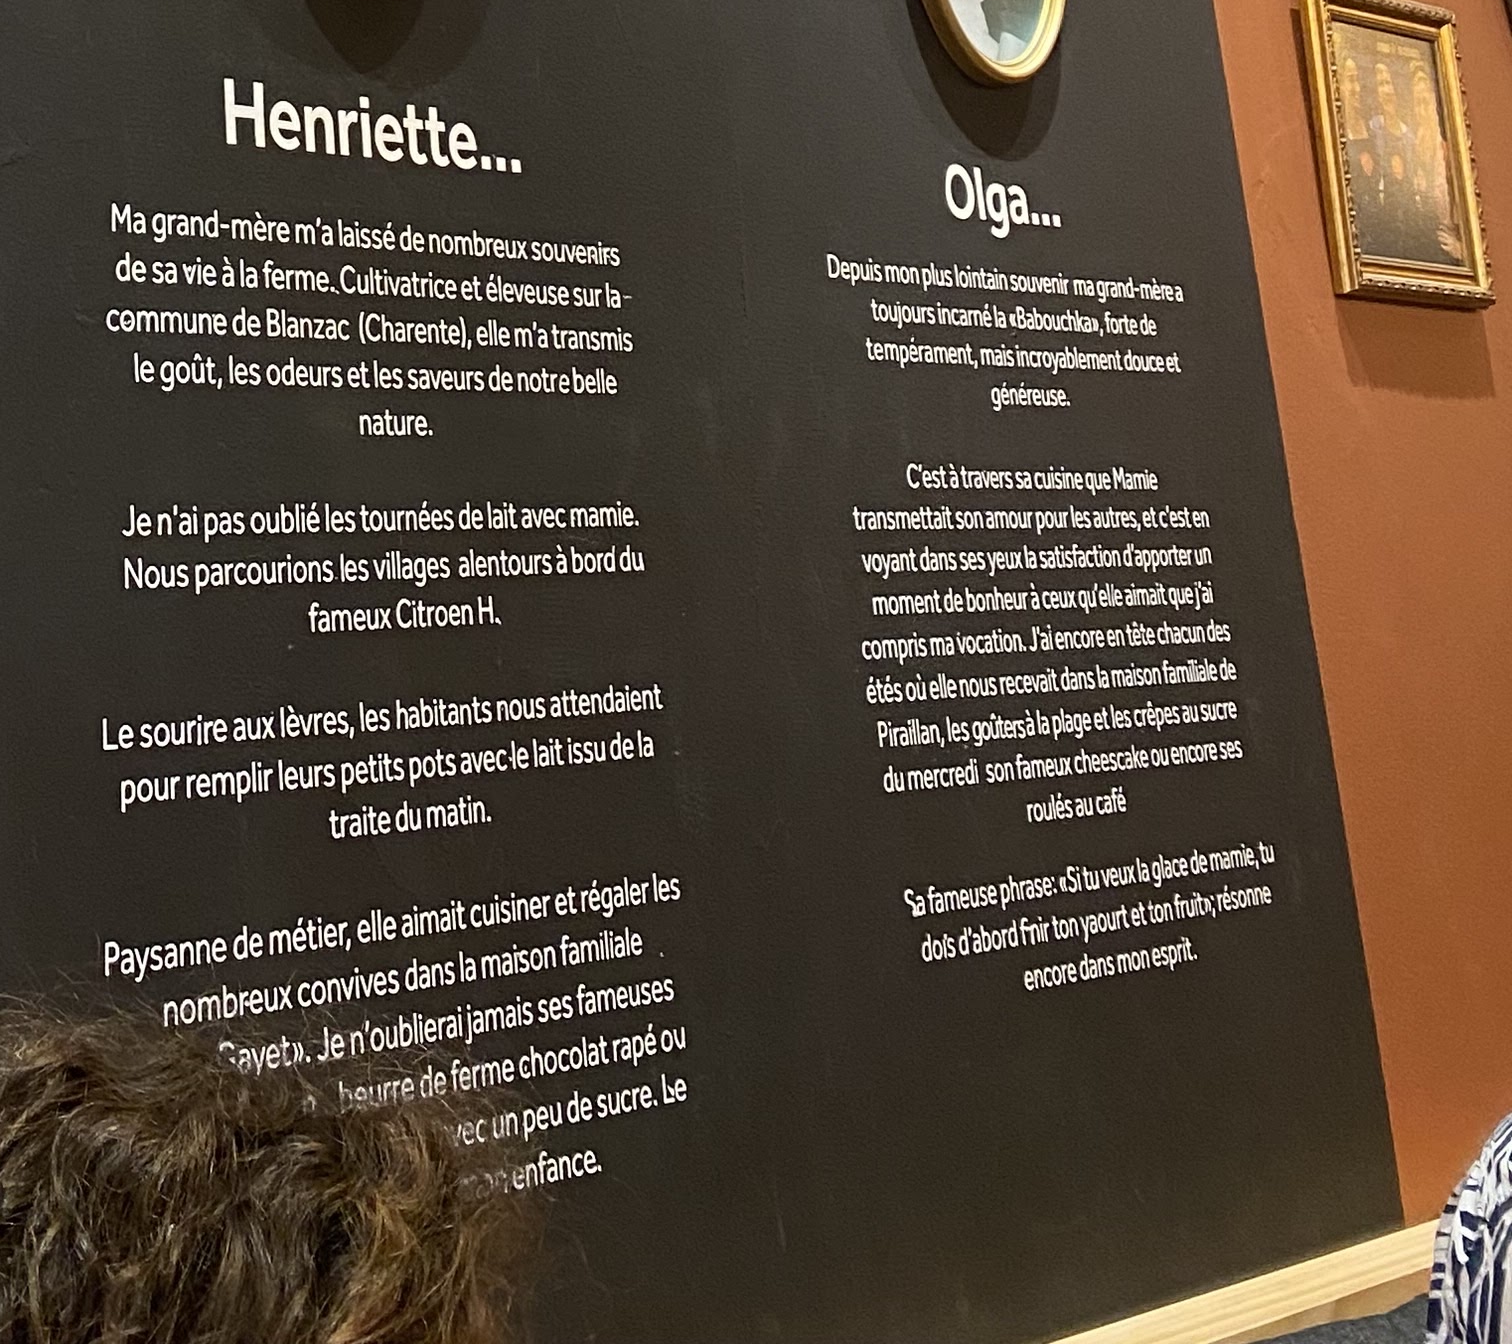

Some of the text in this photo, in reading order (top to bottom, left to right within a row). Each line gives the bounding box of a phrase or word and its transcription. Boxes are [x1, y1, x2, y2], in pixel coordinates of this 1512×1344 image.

[223, 77, 522, 174] Henriette...
[111, 202, 621, 267] Ma grand-mère m'a laissé de nombreux souvenirs
[115, 251, 624, 309] de sa vie à la ferme. Cultivatrice et éleveuse sur la
[826, 253, 883, 287] Depuis
[883, 264, 921, 285] mon
[920, 262, 954, 292] plus
[953, 263, 1009, 291] lointain
[1009, 272, 1070, 296] souvenir
[1072, 278, 1096, 297] ma
[1174, 285, 1185, 303] a
[105, 306, 634, 353] commune de Blanzac (Charente), elle m'a transmis
[870, 298, 937, 330] toujours
[992, 304, 1008, 329] la
[1104, 310, 1139, 336] forte
[1139, 313, 1158, 337] de
[133, 351, 618, 395] le goût, les odeurs et les saveurs de notre belle
[979, 343, 1015, 368] mais
[1014, 344, 1124, 375] incroyablement
[1123, 348, 1165, 373] douce
[1165, 351, 1182, 374] et
[358, 408, 434, 437] nature.
[959, 465, 1014, 490] travers
[1014, 470, 1033, 490] sa
[1033, 465, 1084, 491] cuisine
[1084, 471, 1112, 497] que
[1111, 466, 1159, 491] Mamie
[121, 500, 640, 544] Je n'ai pas oublié les tournées de lait avec mamie.
[123, 543, 645, 595] Nous parcourions les villages alentours à bord du
[307, 601, 393, 633] fameux
[395, 597, 474, 629] Citroen
[861, 631, 928, 666] compris
[929, 636, 956, 657] ma
[1054, 629, 1106, 651] encore
[1106, 628, 1126, 648] en
[1156, 620, 1206, 646] chacun
[1206, 618, 1232, 643] des
[102, 683, 664, 751] Le sourire aux lèvres, les habitants nous attendaient
[120, 729, 655, 814] pour remplir leurs petits pots avec le lait issu de la
[883, 740, 1244, 793] du mercredi son fameux cheescake ou encore ses
[328, 794, 492, 840] traite du matin.
[1074, 796, 1095, 818] au
[104, 872, 681, 983] Paysanne de métier, elle aimait cuisiner et régaler les
[1023, 962, 1078, 992] encore
[1078, 952, 1116, 981] dans
[1116, 949, 1151, 974] mon
